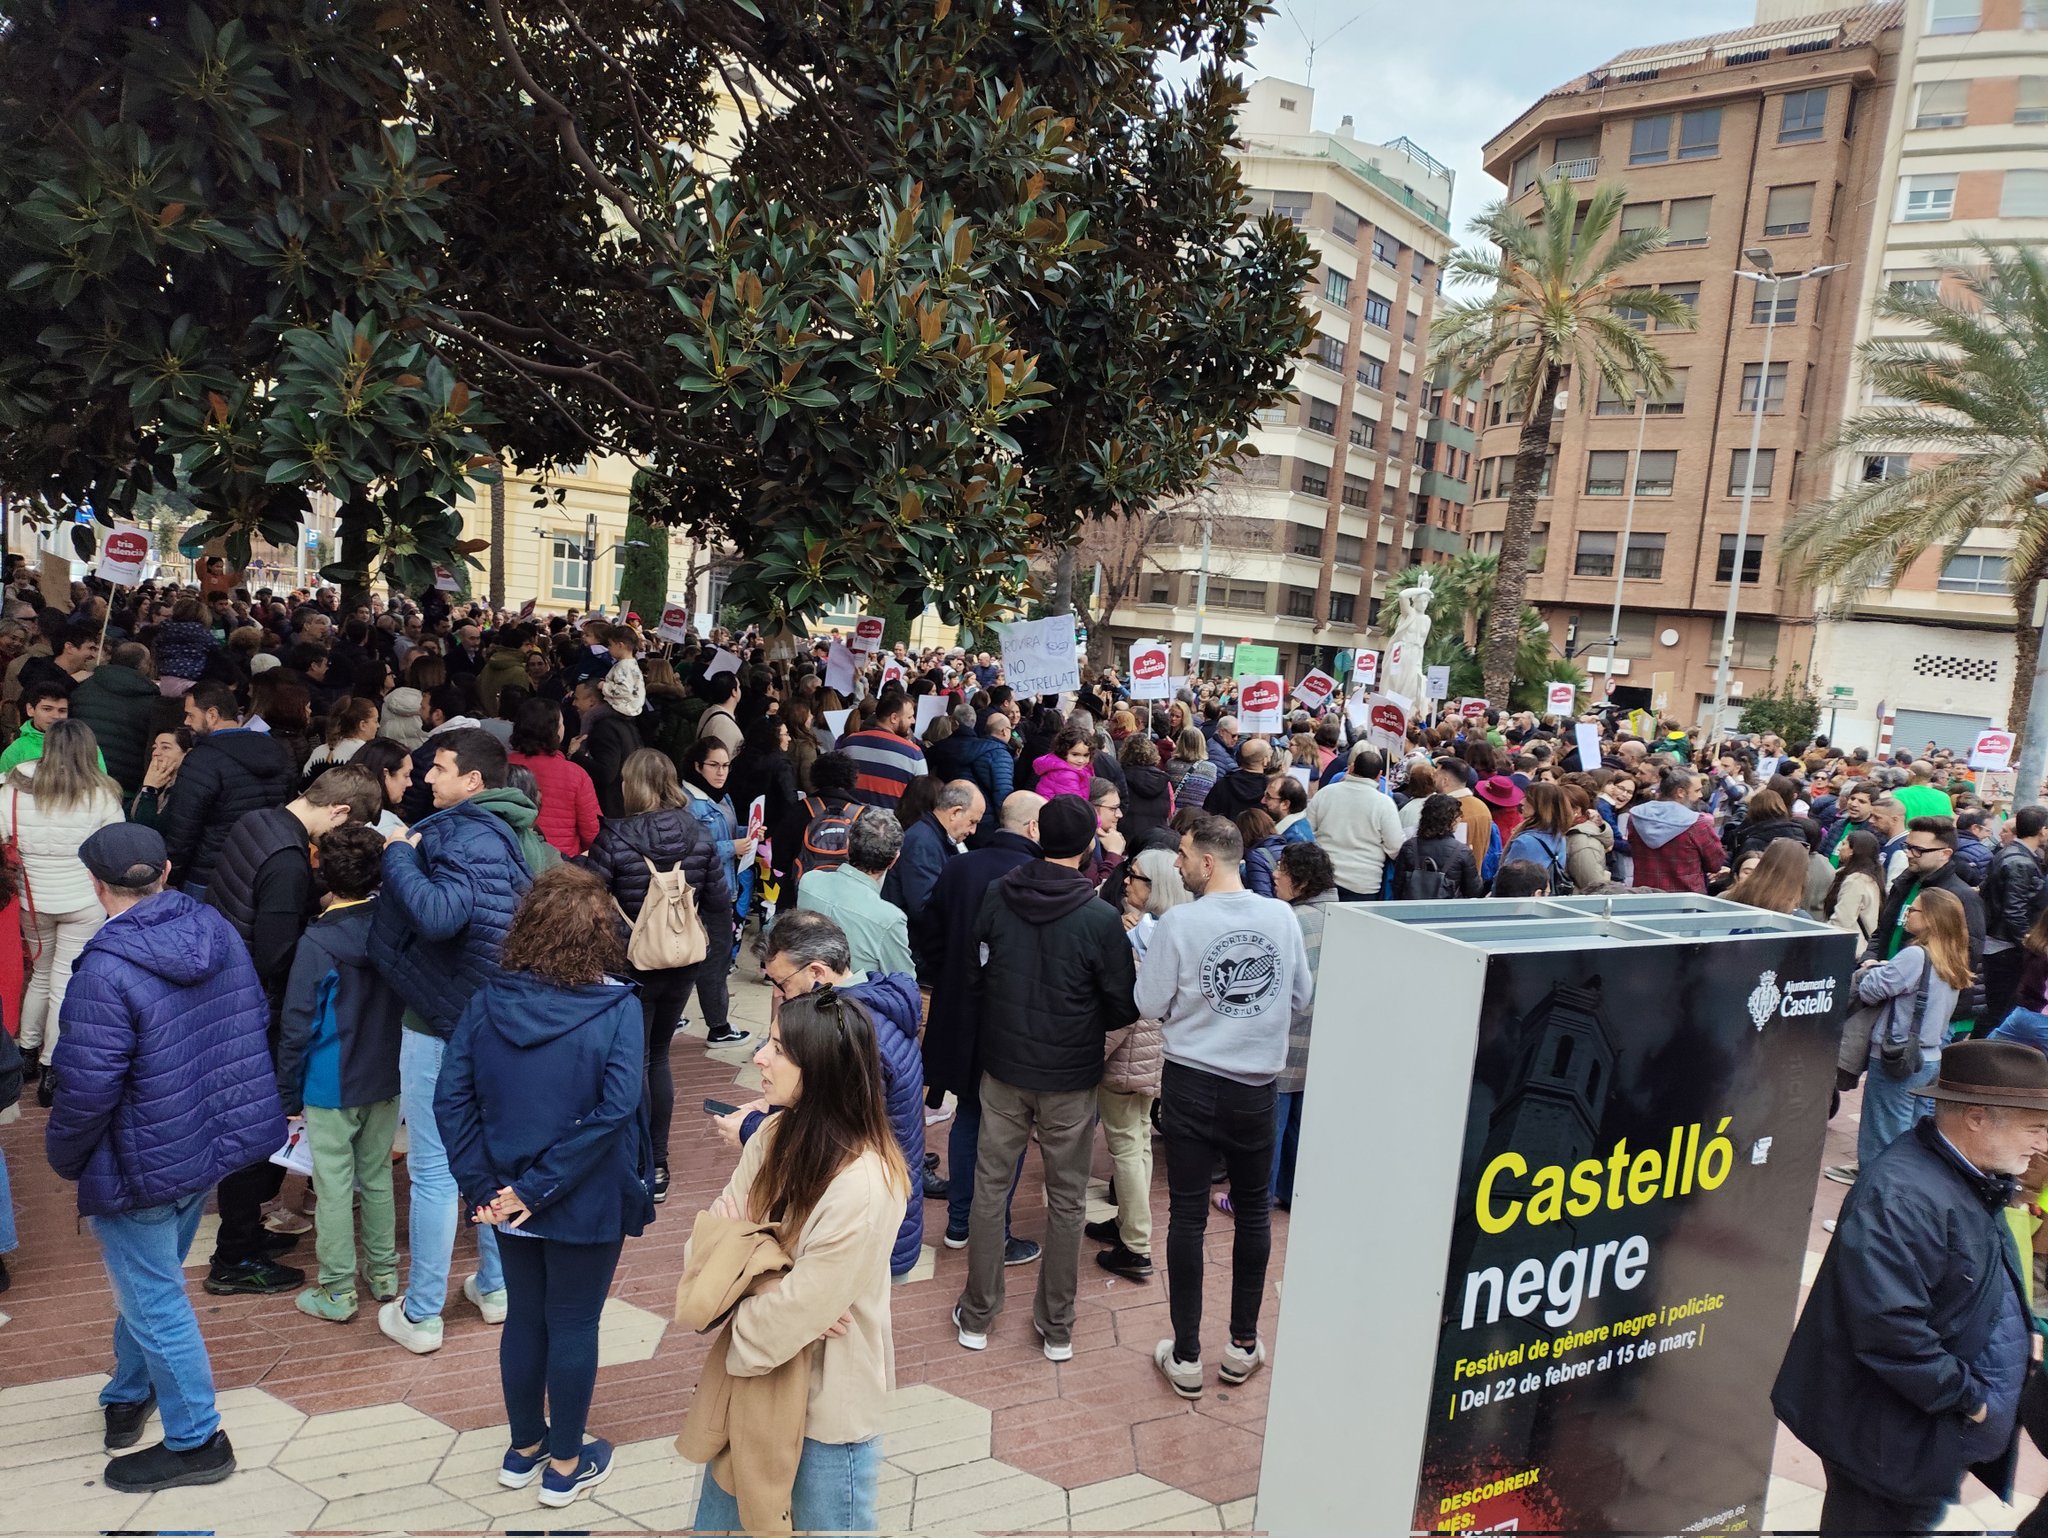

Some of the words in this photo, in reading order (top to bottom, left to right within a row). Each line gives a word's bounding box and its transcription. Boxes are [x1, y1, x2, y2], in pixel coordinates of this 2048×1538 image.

[117, 540, 134, 549] tria
[309, 532, 318, 542] P
[108, 547, 145, 557] valencià
[1004, 635, 1041, 653] ROVIRA
[1008, 659, 1026, 677] NO
[1135, 662, 1165, 675] valencià
[1142, 658, 1156, 666] tria
[1008, 671, 1076, 693] DESTRELLAT
[1244, 694, 1278, 706] valencià
[1253, 689, 1269, 697] tria
[1383, 711, 1398, 720] tria
[1251, 935, 1265, 945] DE
[1204, 934, 1248, 972] D'ESPORTS
[1202, 975, 1215, 999] CLUB
[1784, 979, 1826, 995] Ajuntament
[1826, 976, 1836, 989] de
[1219, 1004, 1262, 1016] COSTUR
[1780, 990, 1833, 1017] Castelló
[1475, 1116, 1734, 1234] Castelló
[1460, 1234, 1650, 1331] negre
[1454, 1344, 1525, 1382] Festival
[1527, 1340, 1548, 1360] de
[1552, 1326, 1609, 1359] gènere
[1612, 1313, 1656, 1341] negre
[1659, 1306, 1666, 1325] i
[1667, 1293, 1725, 1327] policíac
[1460, 1388, 1490, 1412] Del
[1493, 1377, 1517, 1402] 22
[1519, 1371, 1541, 1394] de
[1544, 1357, 1595, 1388] febrer
[1596, 1349, 1612, 1373] al
[1616, 1343, 1634, 1367] 15
[1637, 1338, 1656, 1360] de
[1658, 1329, 1697, 1355] març
[1440, 1467, 1541, 1515] DESCOBREIX
